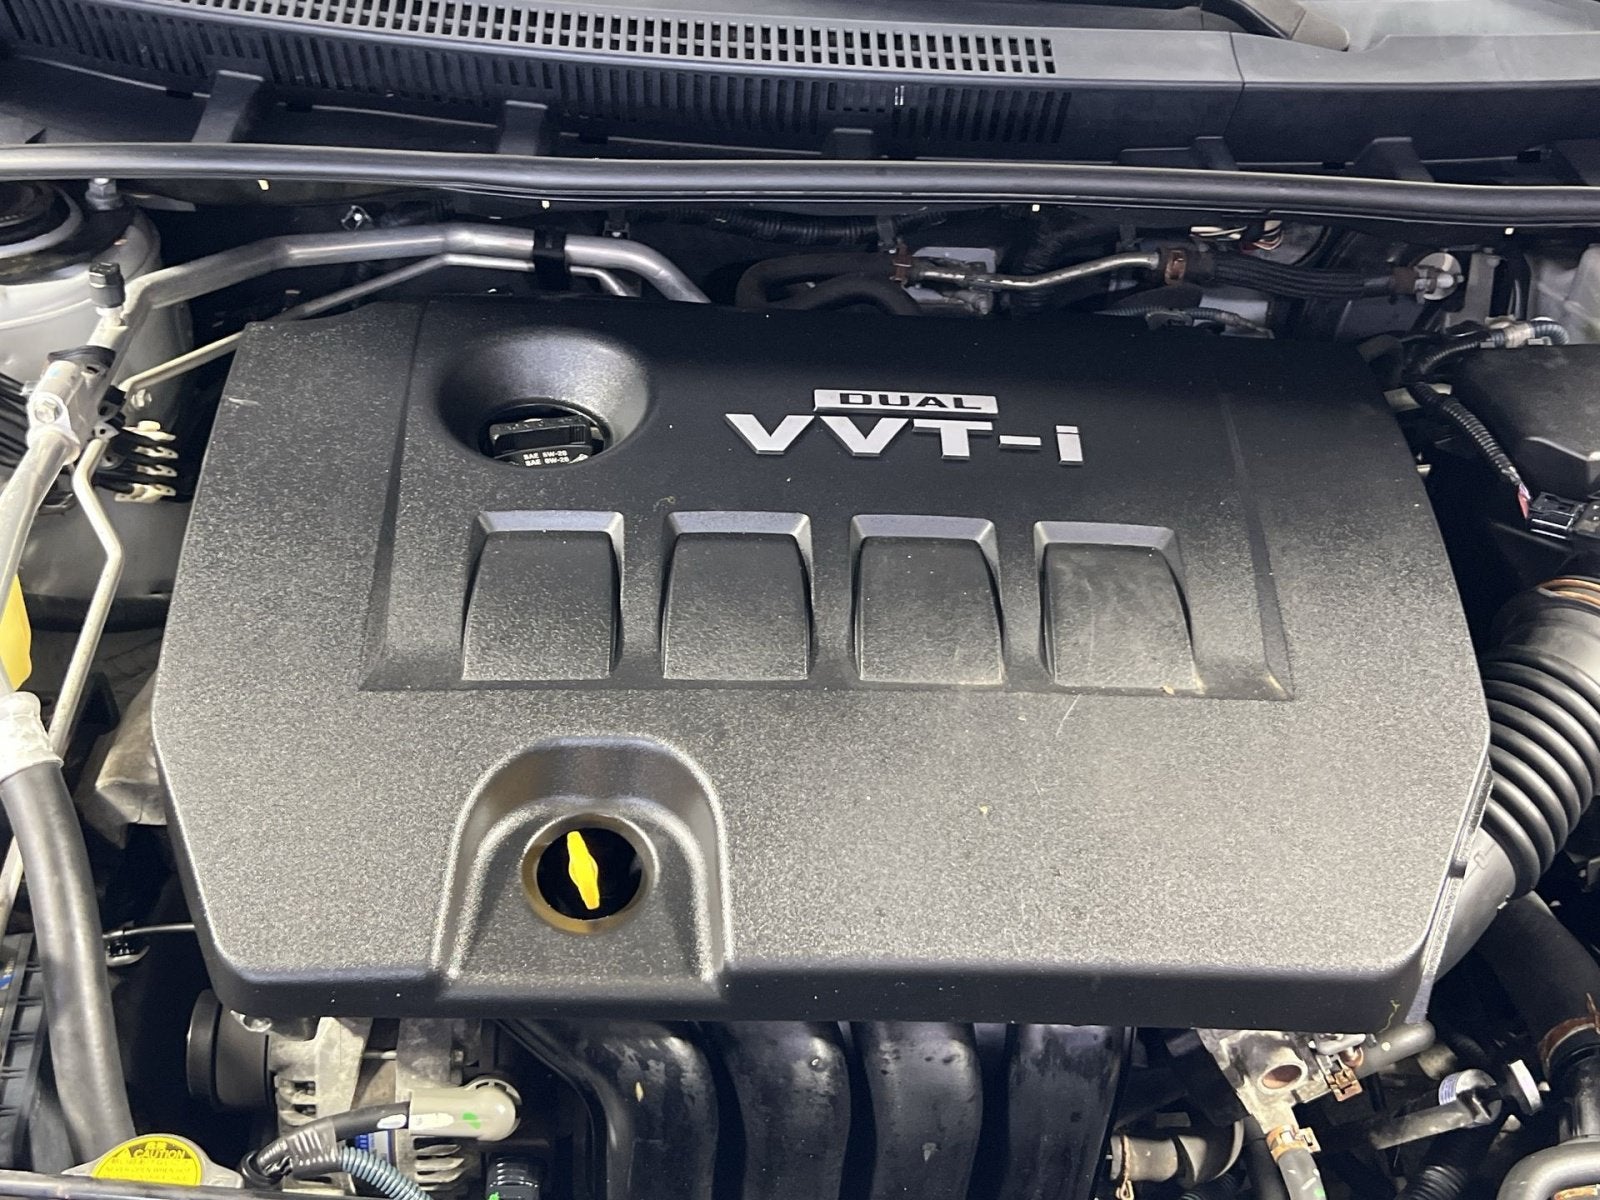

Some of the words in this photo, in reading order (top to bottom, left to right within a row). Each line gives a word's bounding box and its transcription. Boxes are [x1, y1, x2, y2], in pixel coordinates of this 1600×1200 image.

[839, 392, 982, 410] DUAL
[725, 413, 1083, 465] VVT-i
[523, 452, 539, 460] SAE
[525, 458, 541, 467] SAE
[133, 1148, 185, 1159] CAUTION
